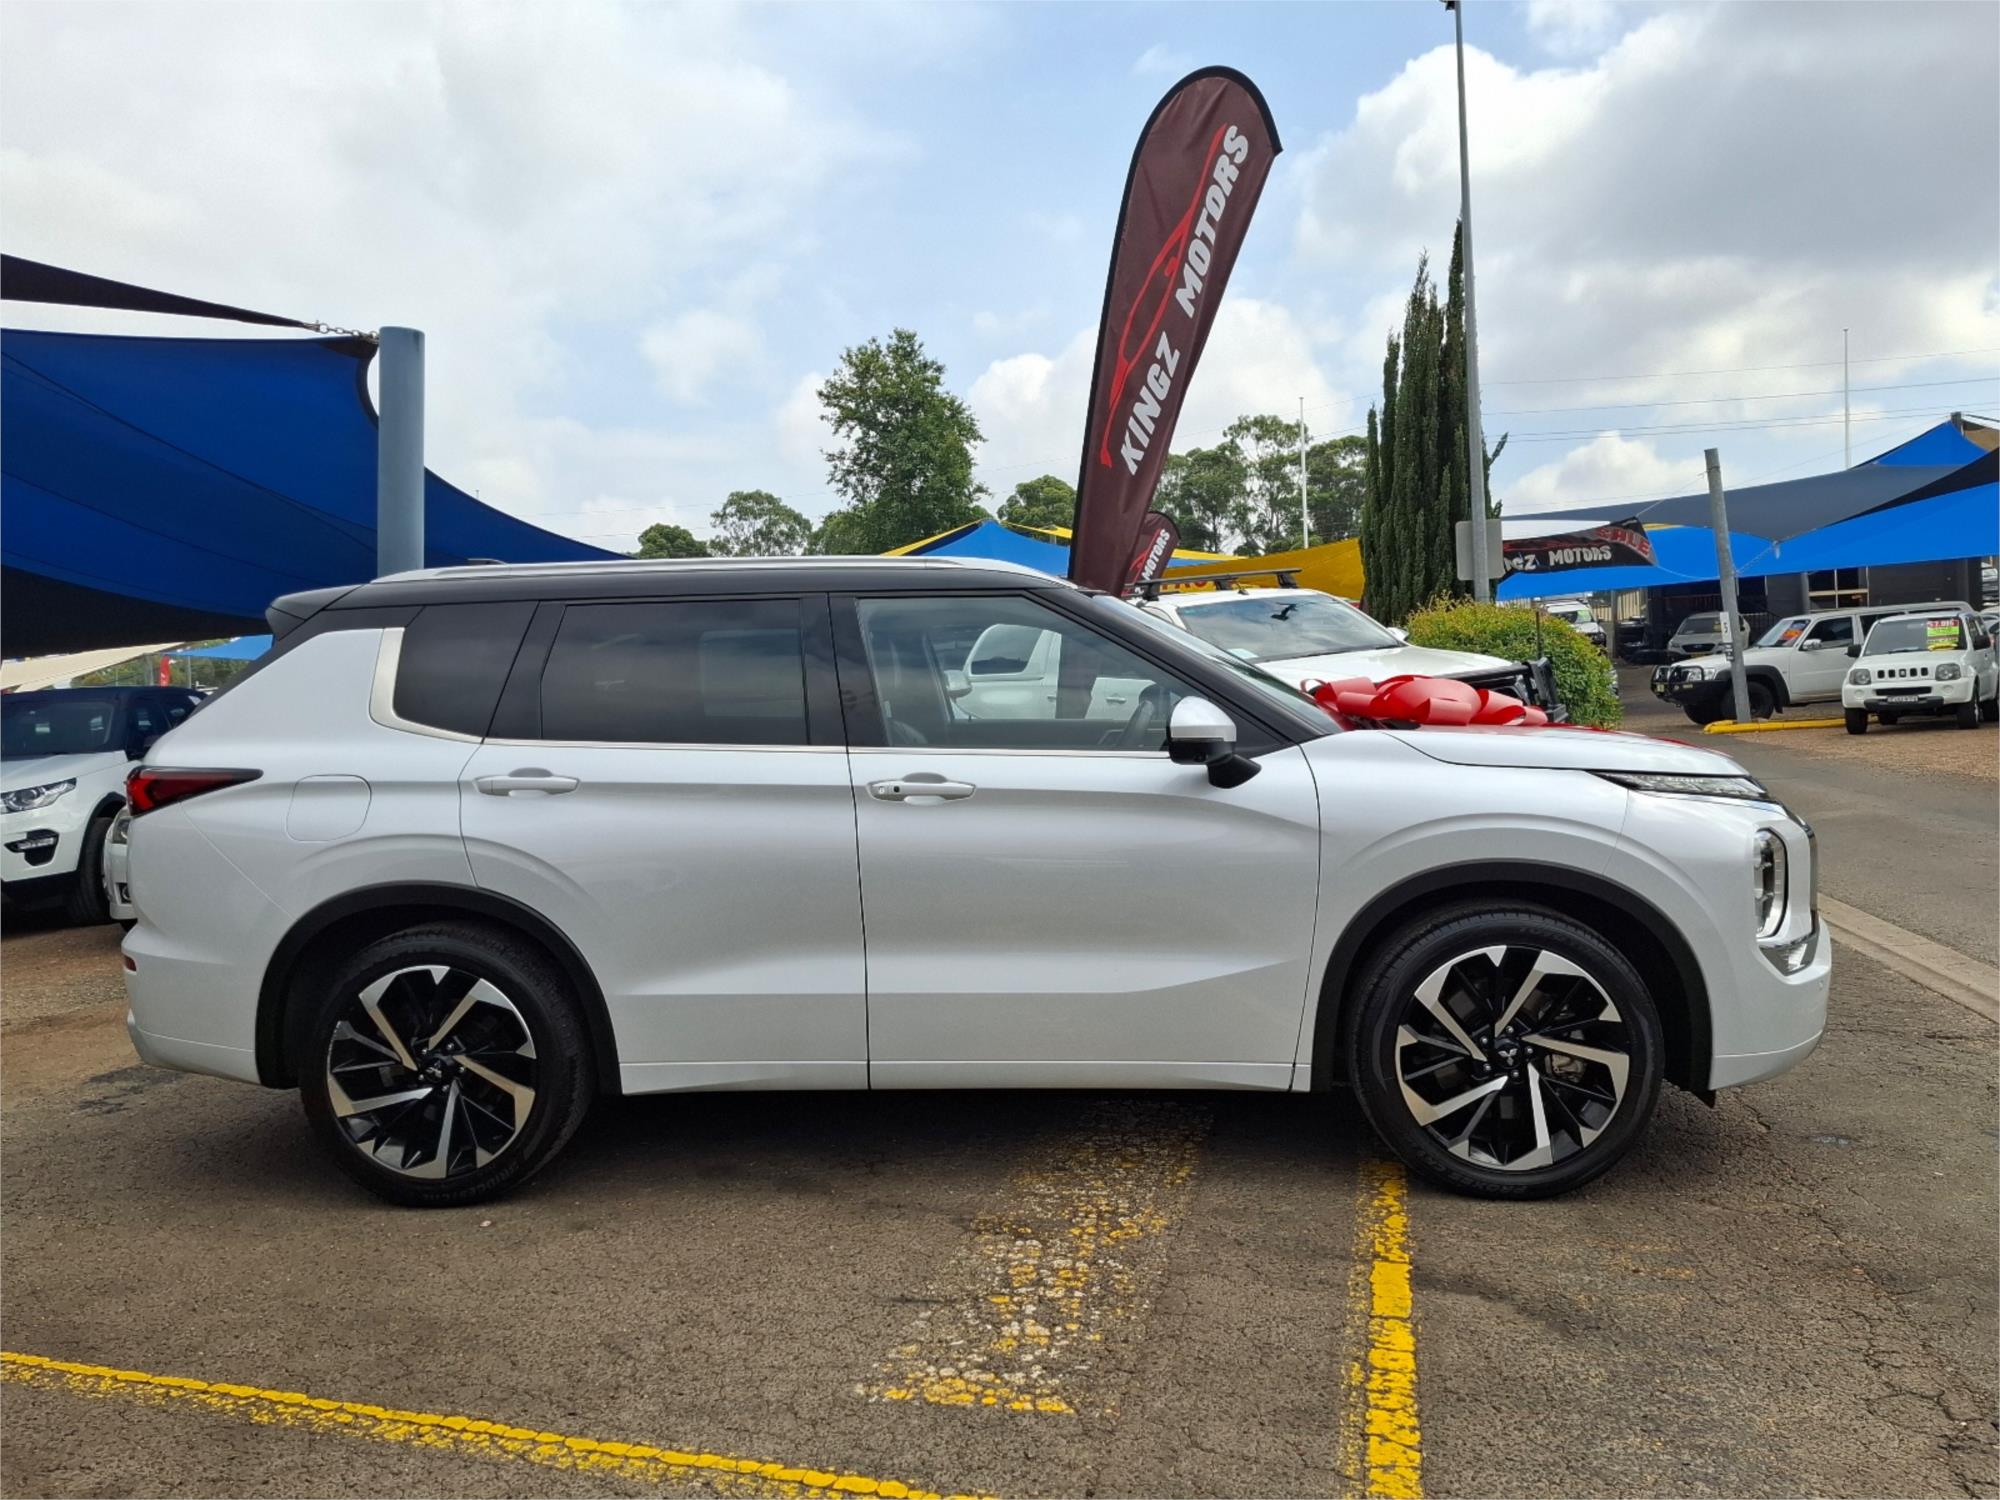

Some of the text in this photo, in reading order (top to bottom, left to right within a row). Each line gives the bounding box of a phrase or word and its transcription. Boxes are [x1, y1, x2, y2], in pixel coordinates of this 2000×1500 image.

[1120, 125, 1249, 476] KINGZ MOTORS
[1141, 528, 1171, 581] MOTORS
[1548, 545, 1612, 566] MOTORS
